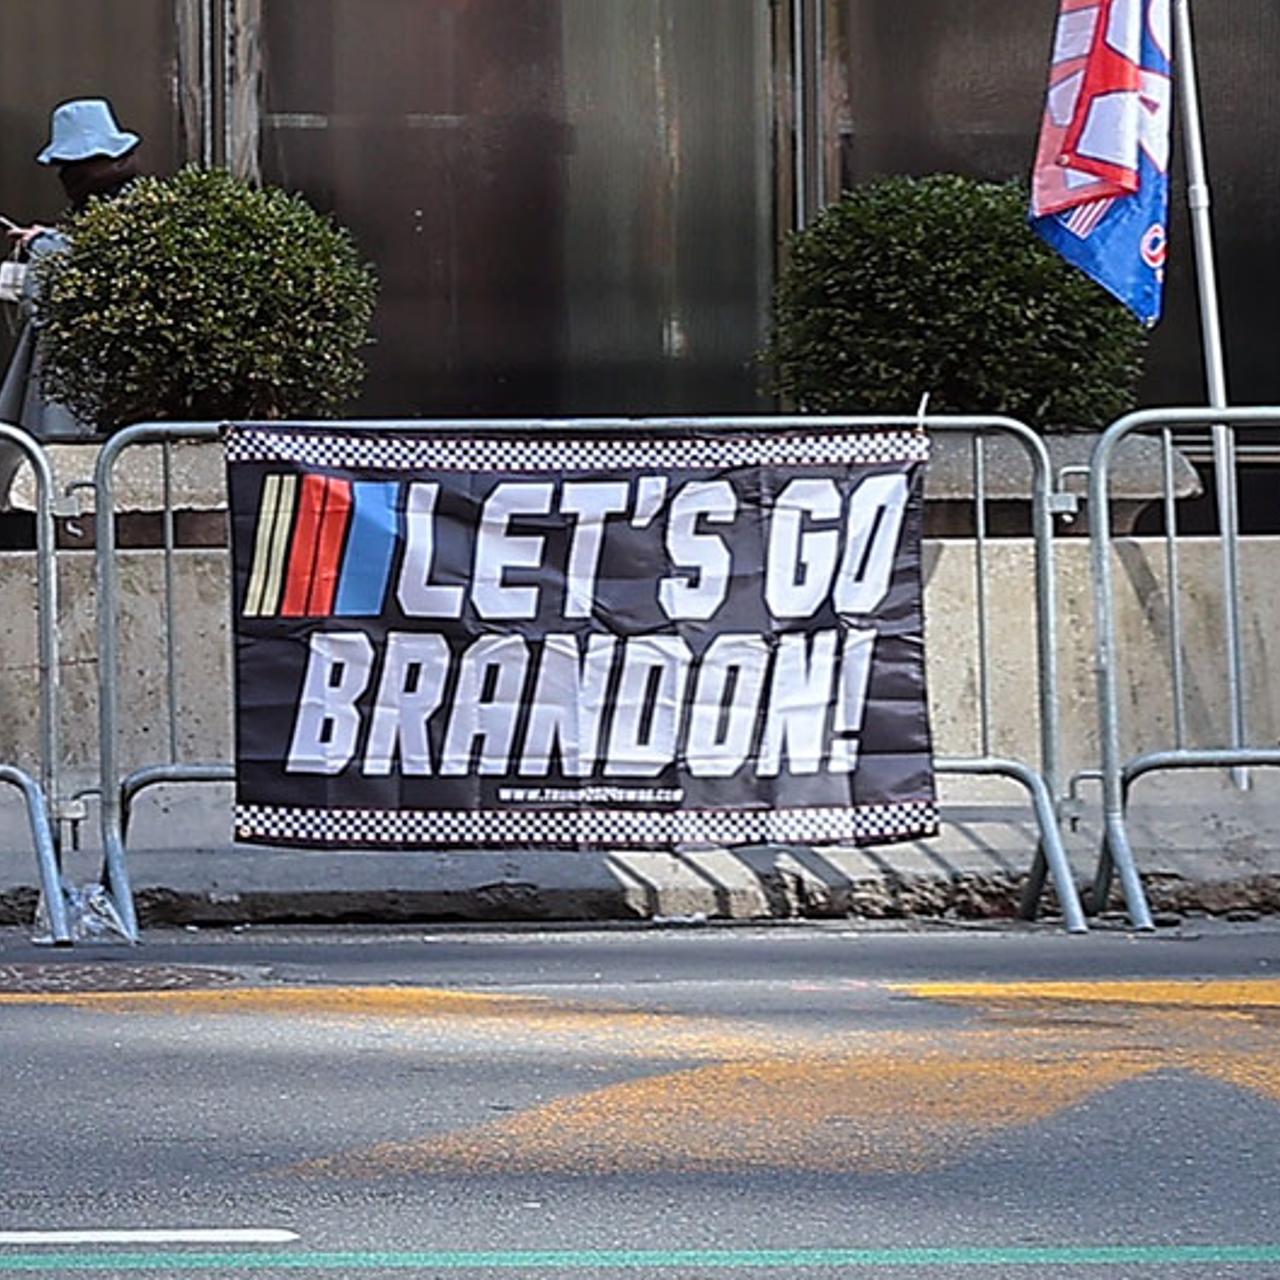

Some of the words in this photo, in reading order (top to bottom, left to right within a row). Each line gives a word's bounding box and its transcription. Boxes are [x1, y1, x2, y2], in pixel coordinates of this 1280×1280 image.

[395, 475, 739, 621] LET'S
[764, 473, 909, 621] GO
[285, 628, 879, 778] BRANDON!
